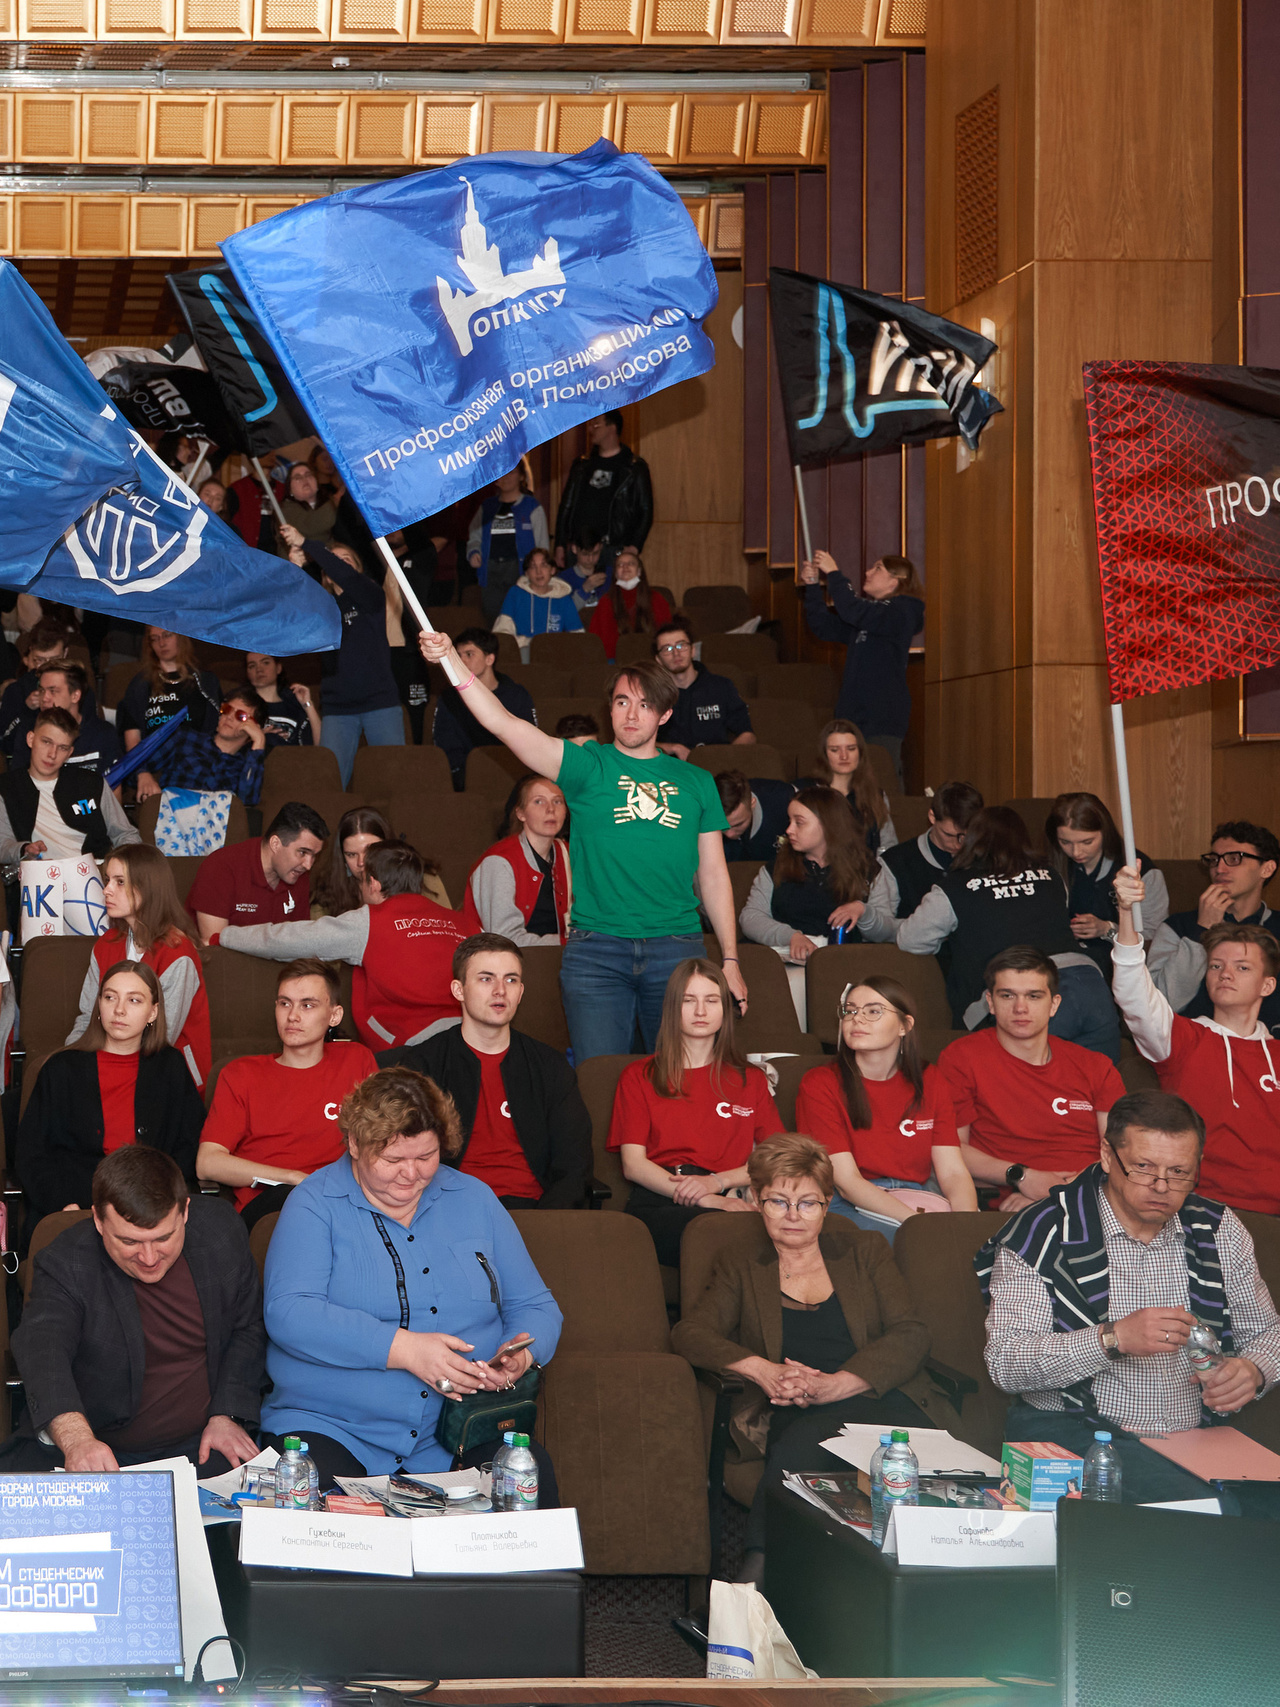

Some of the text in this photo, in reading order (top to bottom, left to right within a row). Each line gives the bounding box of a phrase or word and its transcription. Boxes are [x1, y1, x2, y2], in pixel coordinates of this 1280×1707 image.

[438, 424, 508, 476] имени
[541, 334, 693, 408] Ломоносова
[363, 379, 507, 477] Профсоюзная
[1205, 475, 1280, 530] ПРО
[992, 883, 1036, 900] МГУ
[36, 1480, 110, 1495] СТУДЕНЧЕСКИХ
[2, 1495, 40, 1508] ГОРОДА
[42, 1495, 85, 1507] МОСКВЫ
[308, 1526, 346, 1540] Гужевкин
[471, 1529, 519, 1542] Плотникова
[959, 1525, 994, 1537] Сафонова
[281, 1536, 373, 1552] Константин Сергеевич
[454, 1539, 539, 1553] Татьяна Валерьевна
[931, 1534, 1025, 1549] Наталья Александровна
[18, 1566, 105, 1582] СТУДЕНЧЕСКИХ
